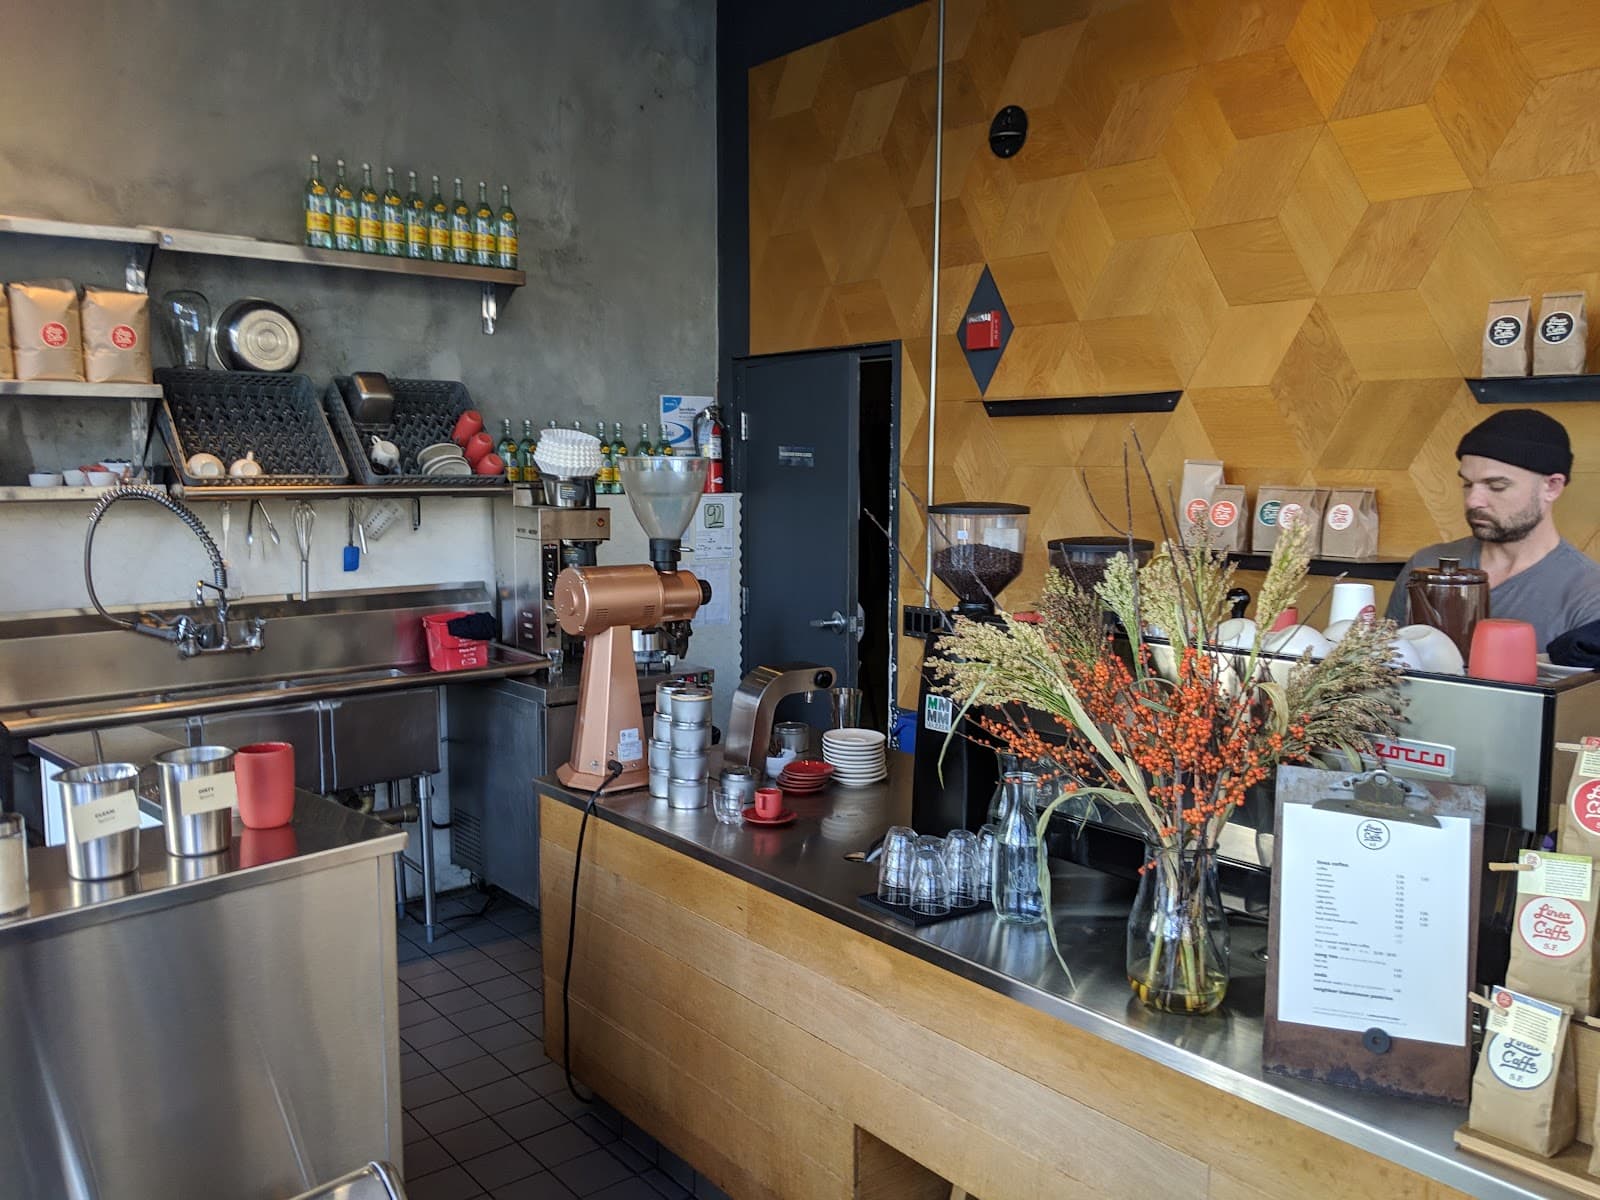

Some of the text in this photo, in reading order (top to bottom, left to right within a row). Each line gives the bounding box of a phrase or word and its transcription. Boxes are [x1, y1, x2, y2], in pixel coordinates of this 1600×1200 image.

[1533, 903, 1574, 925] Linea
[1532, 920, 1571, 942] Caffe
[1499, 1050, 1538, 1074] Caffe
